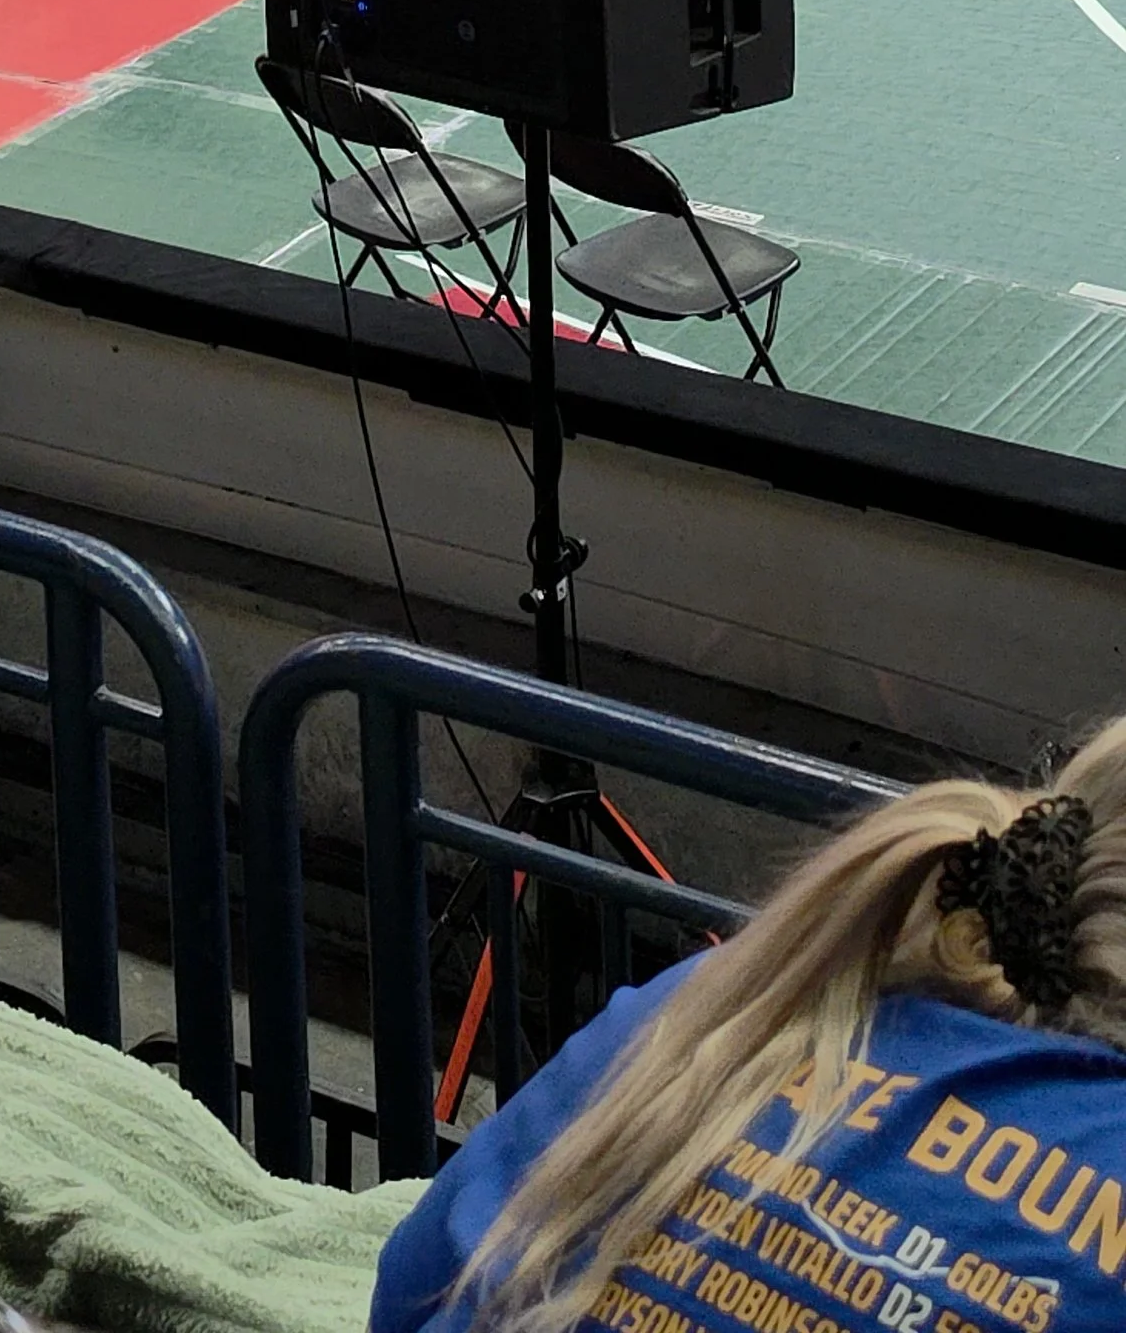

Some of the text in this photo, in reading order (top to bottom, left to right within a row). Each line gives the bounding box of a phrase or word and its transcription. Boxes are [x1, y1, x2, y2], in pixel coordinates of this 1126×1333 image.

[758, 1217, 884, 1311] VITALLO
[878, 1282, 933, 1333] D2
[813, 1180, 898, 1247] LEEK
[895, 1225, 948, 1271] D1
[947, 1253, 1059, 1333] 60LBS
